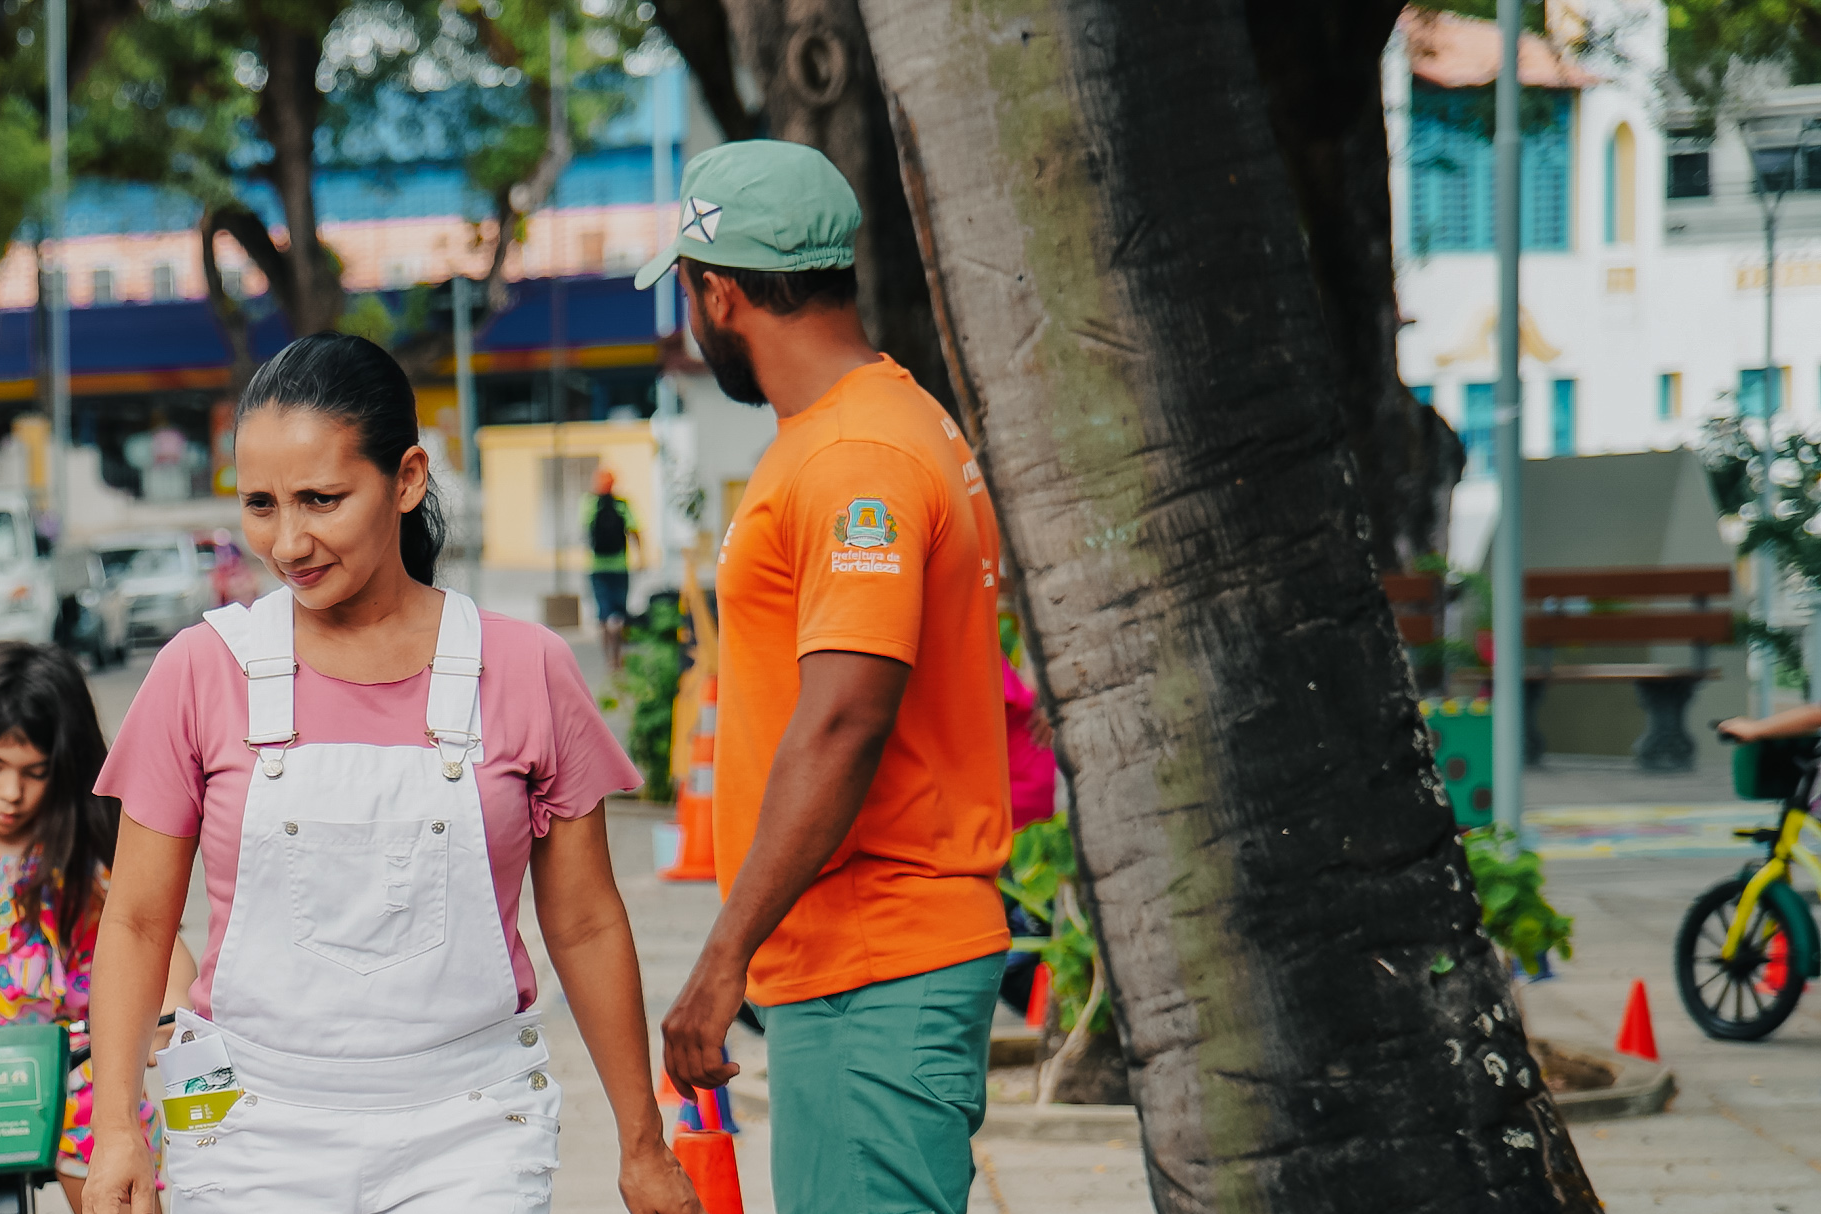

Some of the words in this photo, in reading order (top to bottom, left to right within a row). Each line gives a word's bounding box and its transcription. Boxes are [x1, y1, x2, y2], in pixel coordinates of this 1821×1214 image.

[832, 550, 884, 561] Prefeitura
[887, 552, 900, 562] de
[832, 560, 900, 574] Fortaleza
